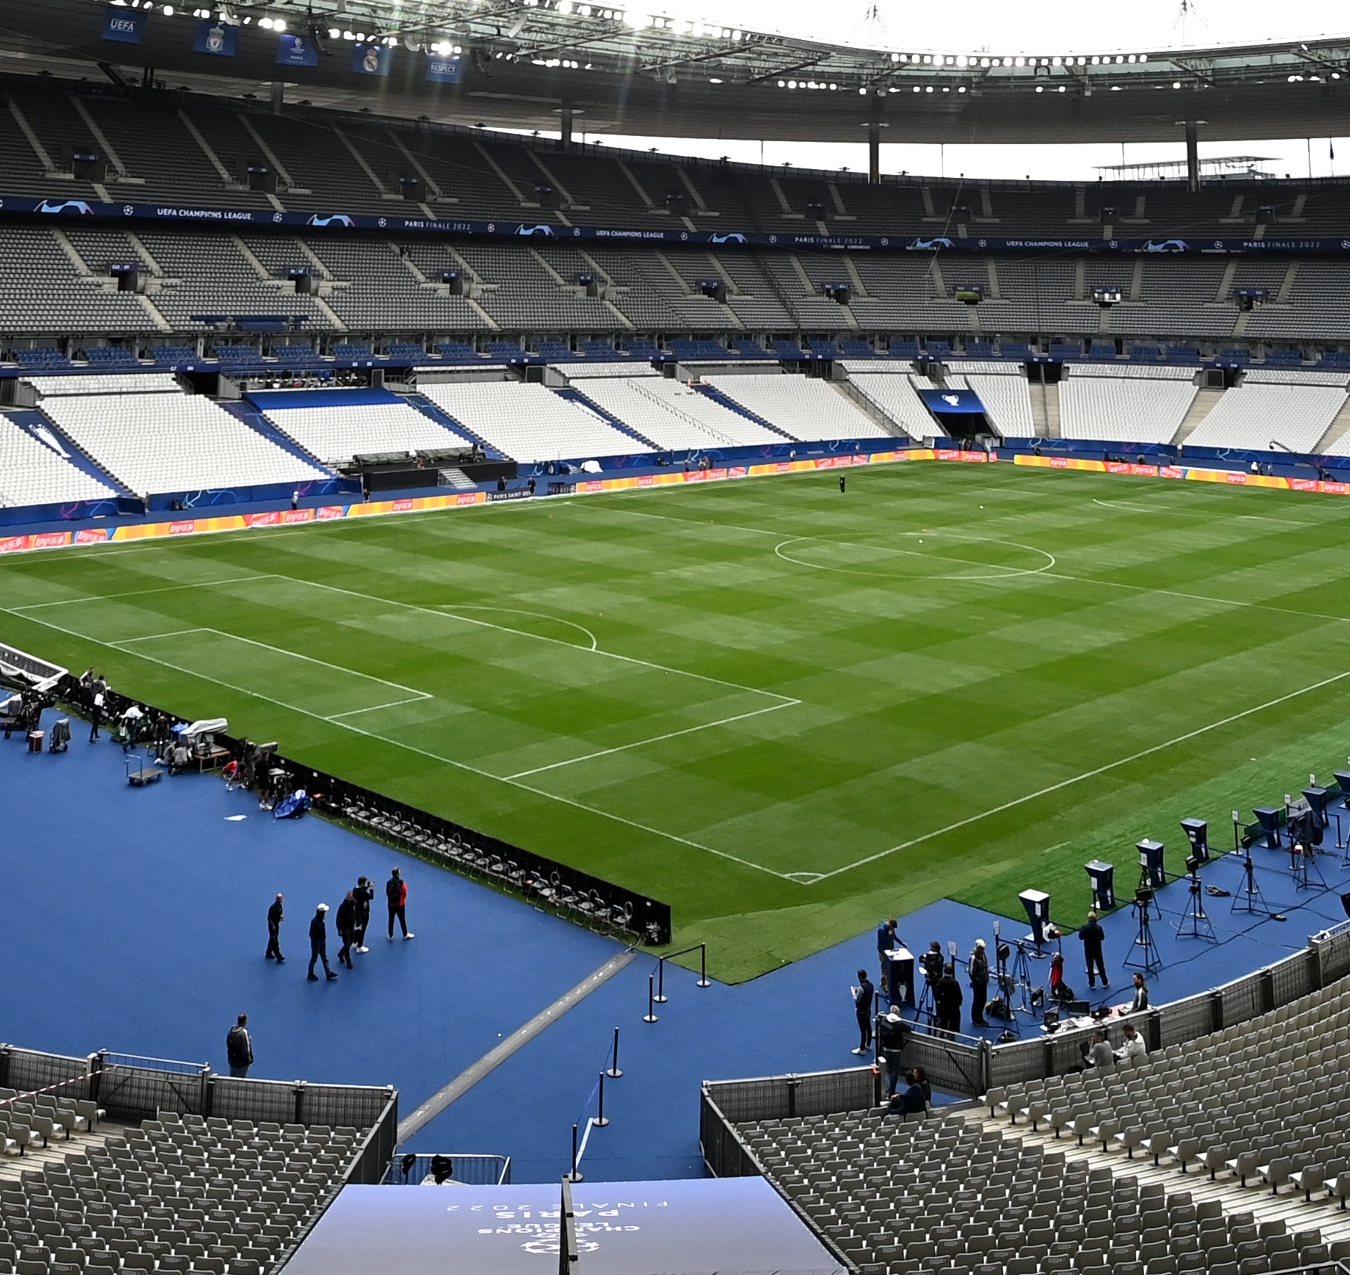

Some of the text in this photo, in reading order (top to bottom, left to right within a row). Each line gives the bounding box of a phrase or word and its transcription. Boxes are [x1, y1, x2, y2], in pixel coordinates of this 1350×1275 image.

[110, 20, 134, 32] UEFA
[430, 63, 455, 73] RESPECT
[157, 208, 252, 220] UEFA CHAMPIONS LEAGUE
[404, 220, 424, 228] PARIS
[425, 221, 450, 229] FINALE
[447, 1204, 530, 1212] 2022
[496, 1209, 619, 1219] PARIS
[506, 1222, 609, 1230] LEGUE
